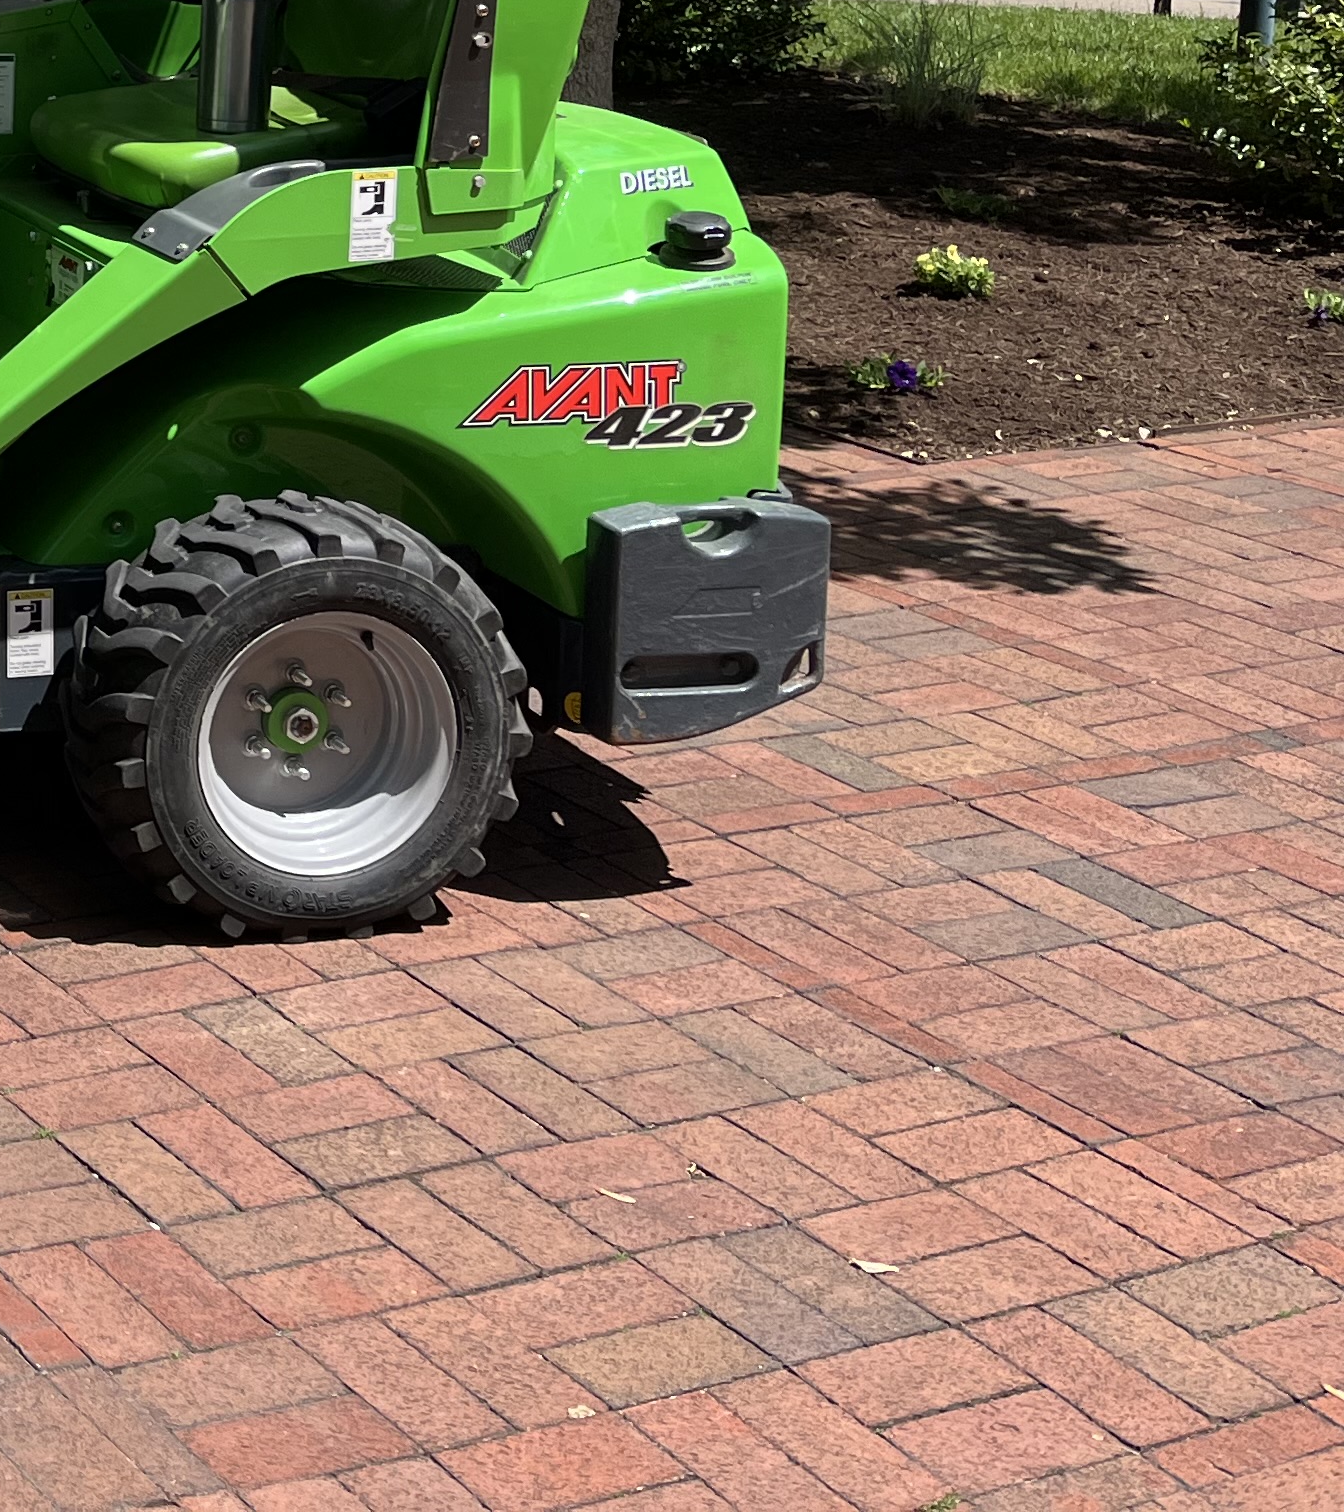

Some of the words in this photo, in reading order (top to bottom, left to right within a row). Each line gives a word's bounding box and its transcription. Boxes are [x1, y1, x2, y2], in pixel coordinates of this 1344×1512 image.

[619, 165, 694, 195] DIESEL
[455, 359, 683, 430] AVANT
[584, 401, 757, 451] 423
